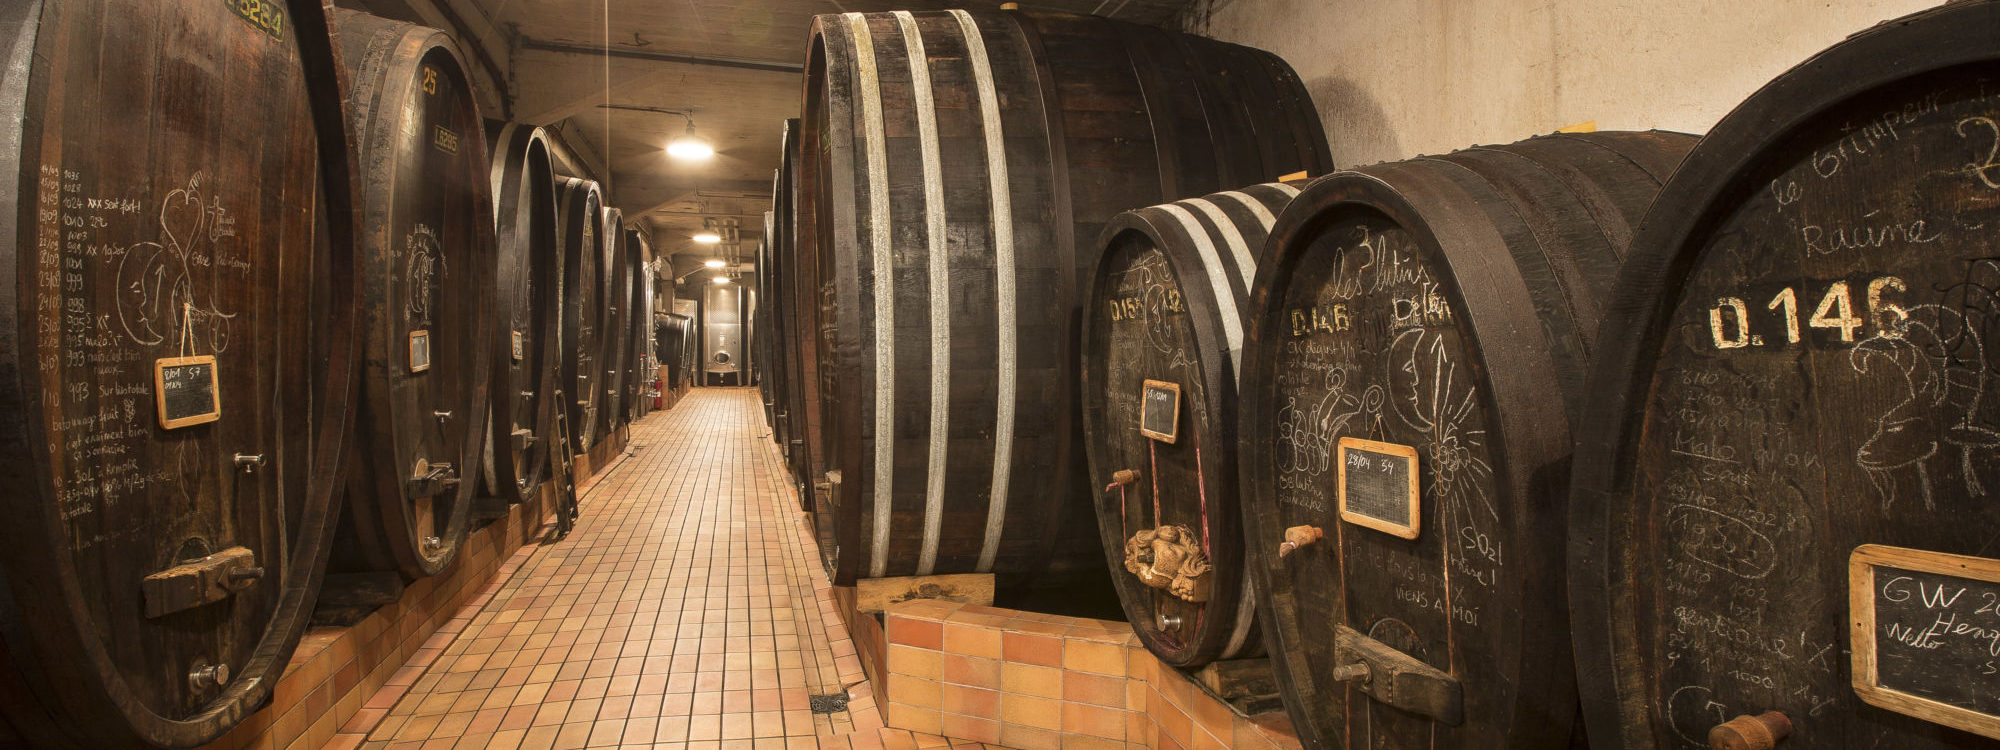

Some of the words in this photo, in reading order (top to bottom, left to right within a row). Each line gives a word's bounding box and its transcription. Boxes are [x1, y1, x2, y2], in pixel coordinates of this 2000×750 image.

[424, 66, 437, 95] 25
[1347, 453, 1371, 470] 28/04
[1381, 459, 1395, 476] 54
